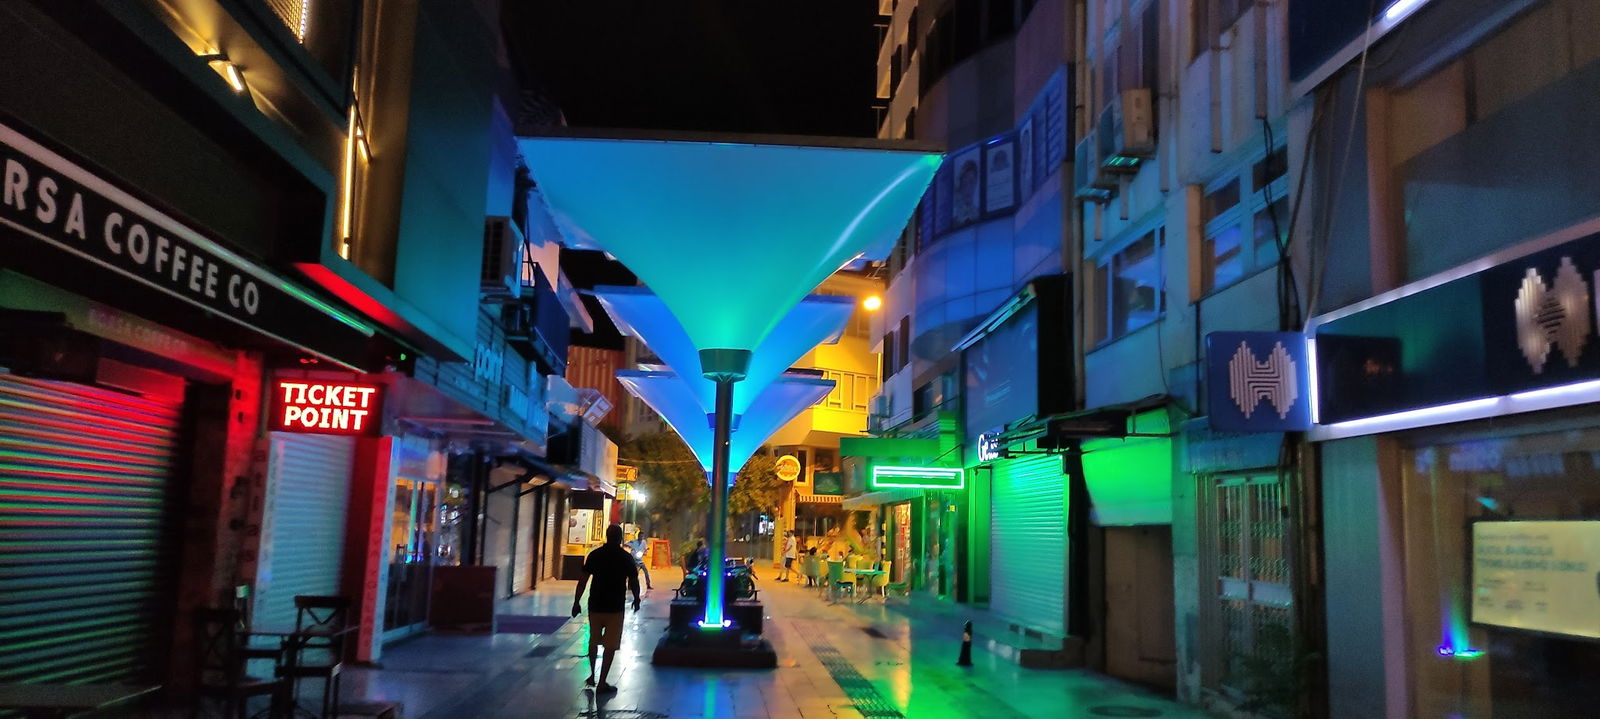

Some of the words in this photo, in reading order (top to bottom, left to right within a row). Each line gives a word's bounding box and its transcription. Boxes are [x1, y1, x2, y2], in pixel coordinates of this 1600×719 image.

[104, 212, 218, 298] COFFEE
[228, 274, 259, 315] CO
[280, 382, 375, 408] TICKET
[284, 405, 368, 430] POINT
